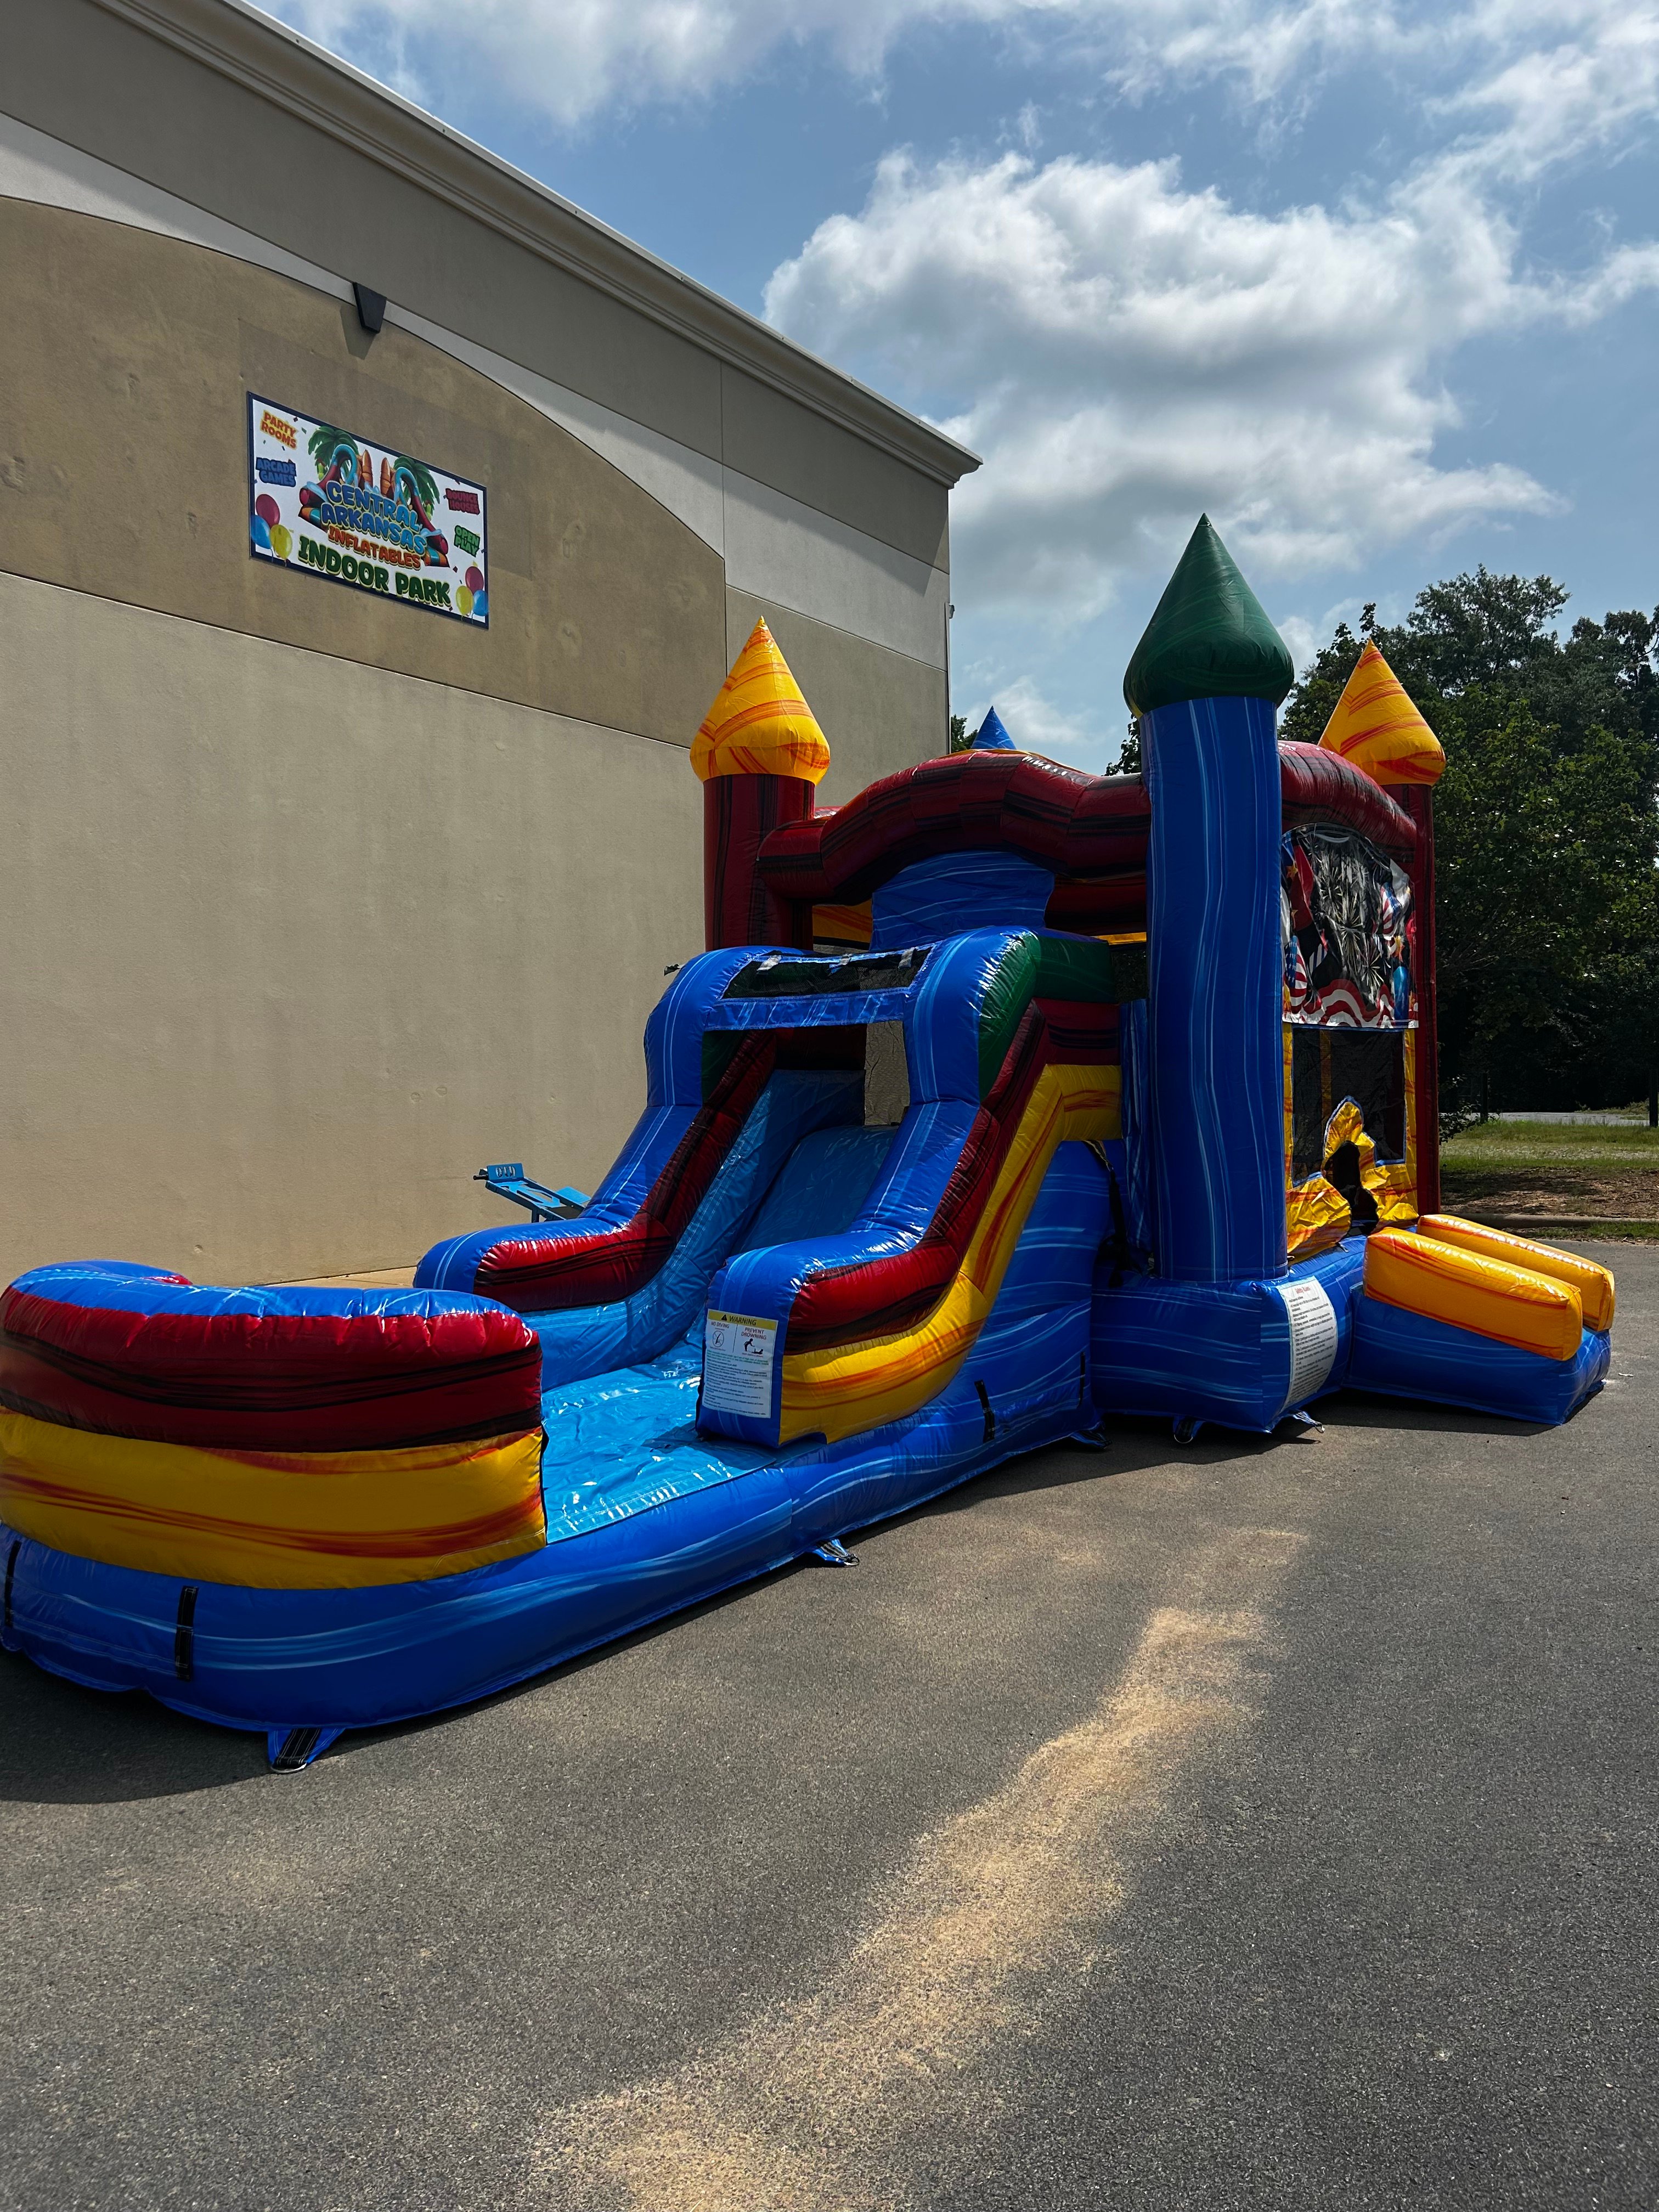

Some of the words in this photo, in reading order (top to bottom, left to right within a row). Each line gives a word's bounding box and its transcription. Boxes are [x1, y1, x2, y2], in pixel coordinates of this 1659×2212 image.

[264, 412, 297, 437] PARTY
[261, 421, 297, 449] ROOMS
[257, 459, 296, 476] ARCADE
[260, 470, 295, 487] GAMES
[326, 481, 421, 531] CENTRAL
[446, 489, 478, 504] BOUNCE
[450, 500, 479, 513] HOUSES
[321, 503, 426, 554] ARKANSAS
[455, 527, 479, 546] OPEN
[328, 526, 421, 569] INFLATABLES
[455, 535, 478, 556] PLAY
[298, 535, 389, 591] INDOOR
[396, 572, 451, 606] PARK
[729, 1316, 757, 1325] WARNING
[741, 1331, 767, 1340] DROWNING
